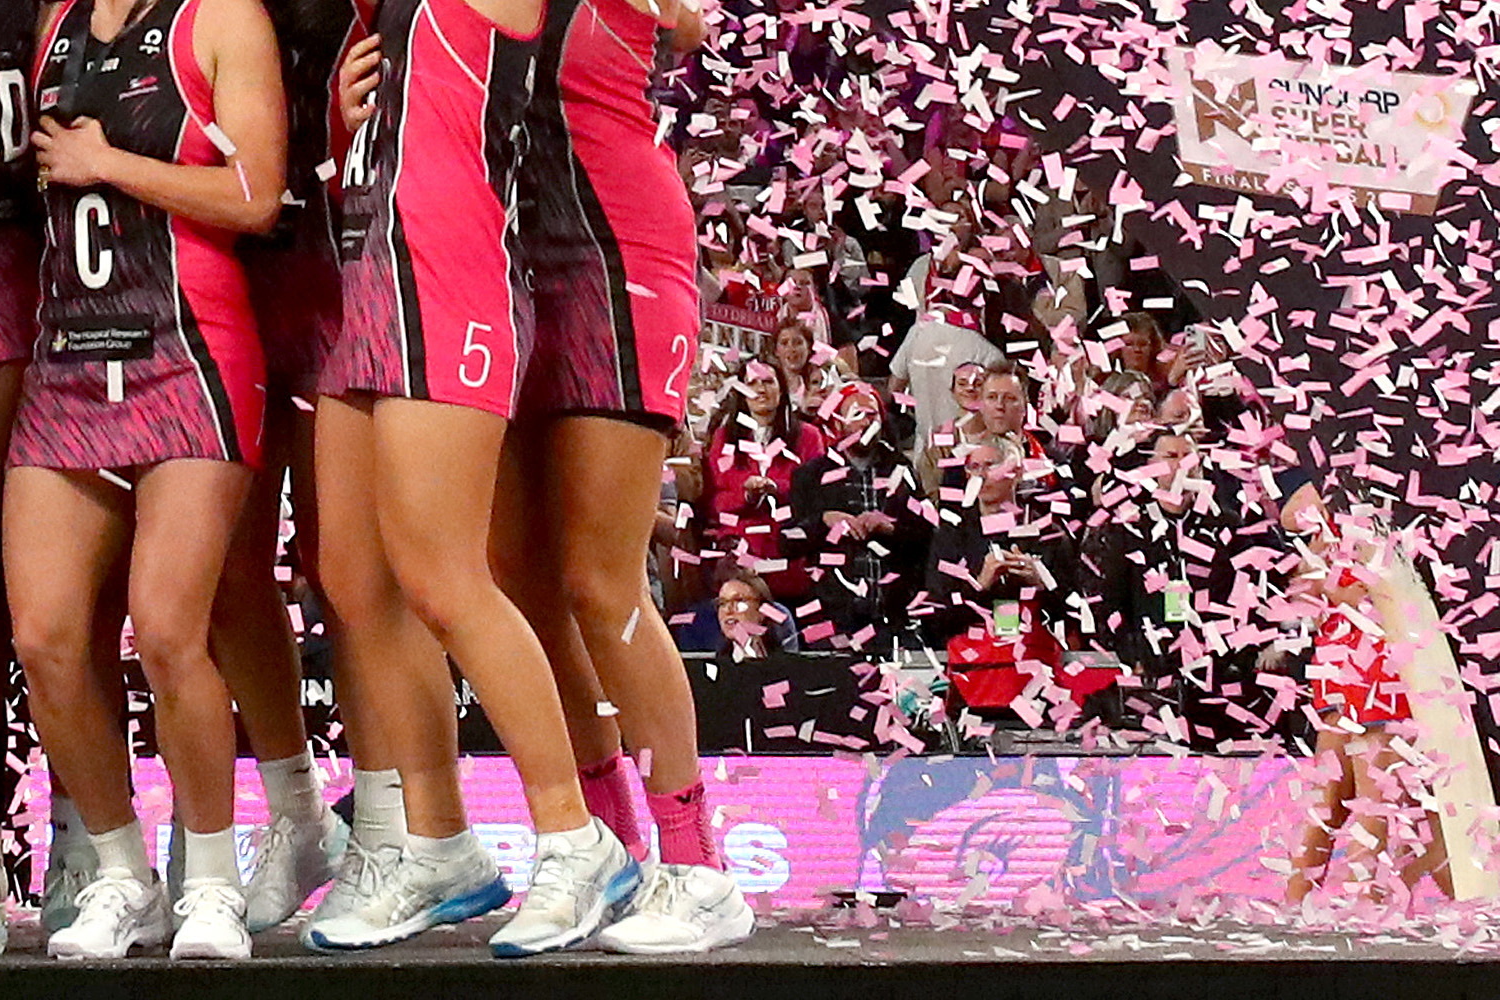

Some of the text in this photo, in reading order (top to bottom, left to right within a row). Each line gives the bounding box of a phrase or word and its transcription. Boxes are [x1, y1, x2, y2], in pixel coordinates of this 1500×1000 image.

[1202, 169, 1268, 192] FINAL
[74, 192, 113, 290] C
[458, 320, 492, 388] 5
[663, 333, 689, 398] 2
